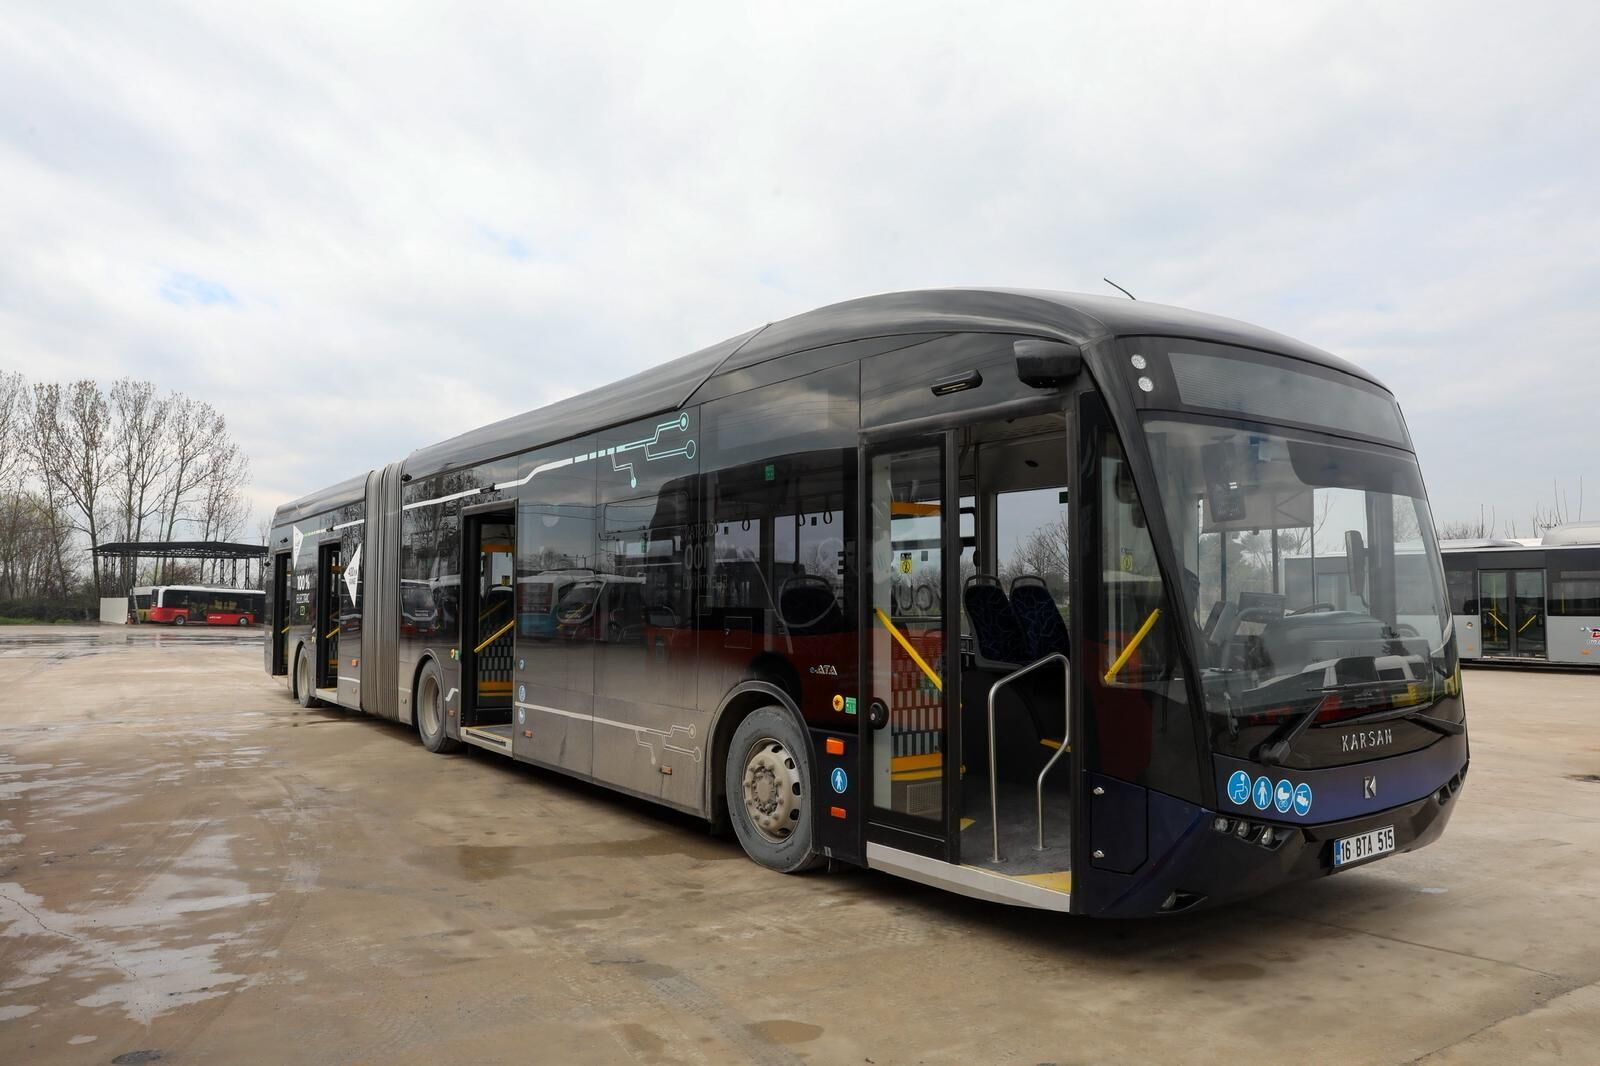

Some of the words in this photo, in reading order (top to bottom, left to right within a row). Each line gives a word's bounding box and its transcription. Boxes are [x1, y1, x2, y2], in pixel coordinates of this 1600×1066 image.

[1341, 728, 1393, 752] KARSAN
[1341, 840, 1351, 861] 16
[1356, 835, 1373, 857] BTA
[1377, 829, 1393, 851] 515
